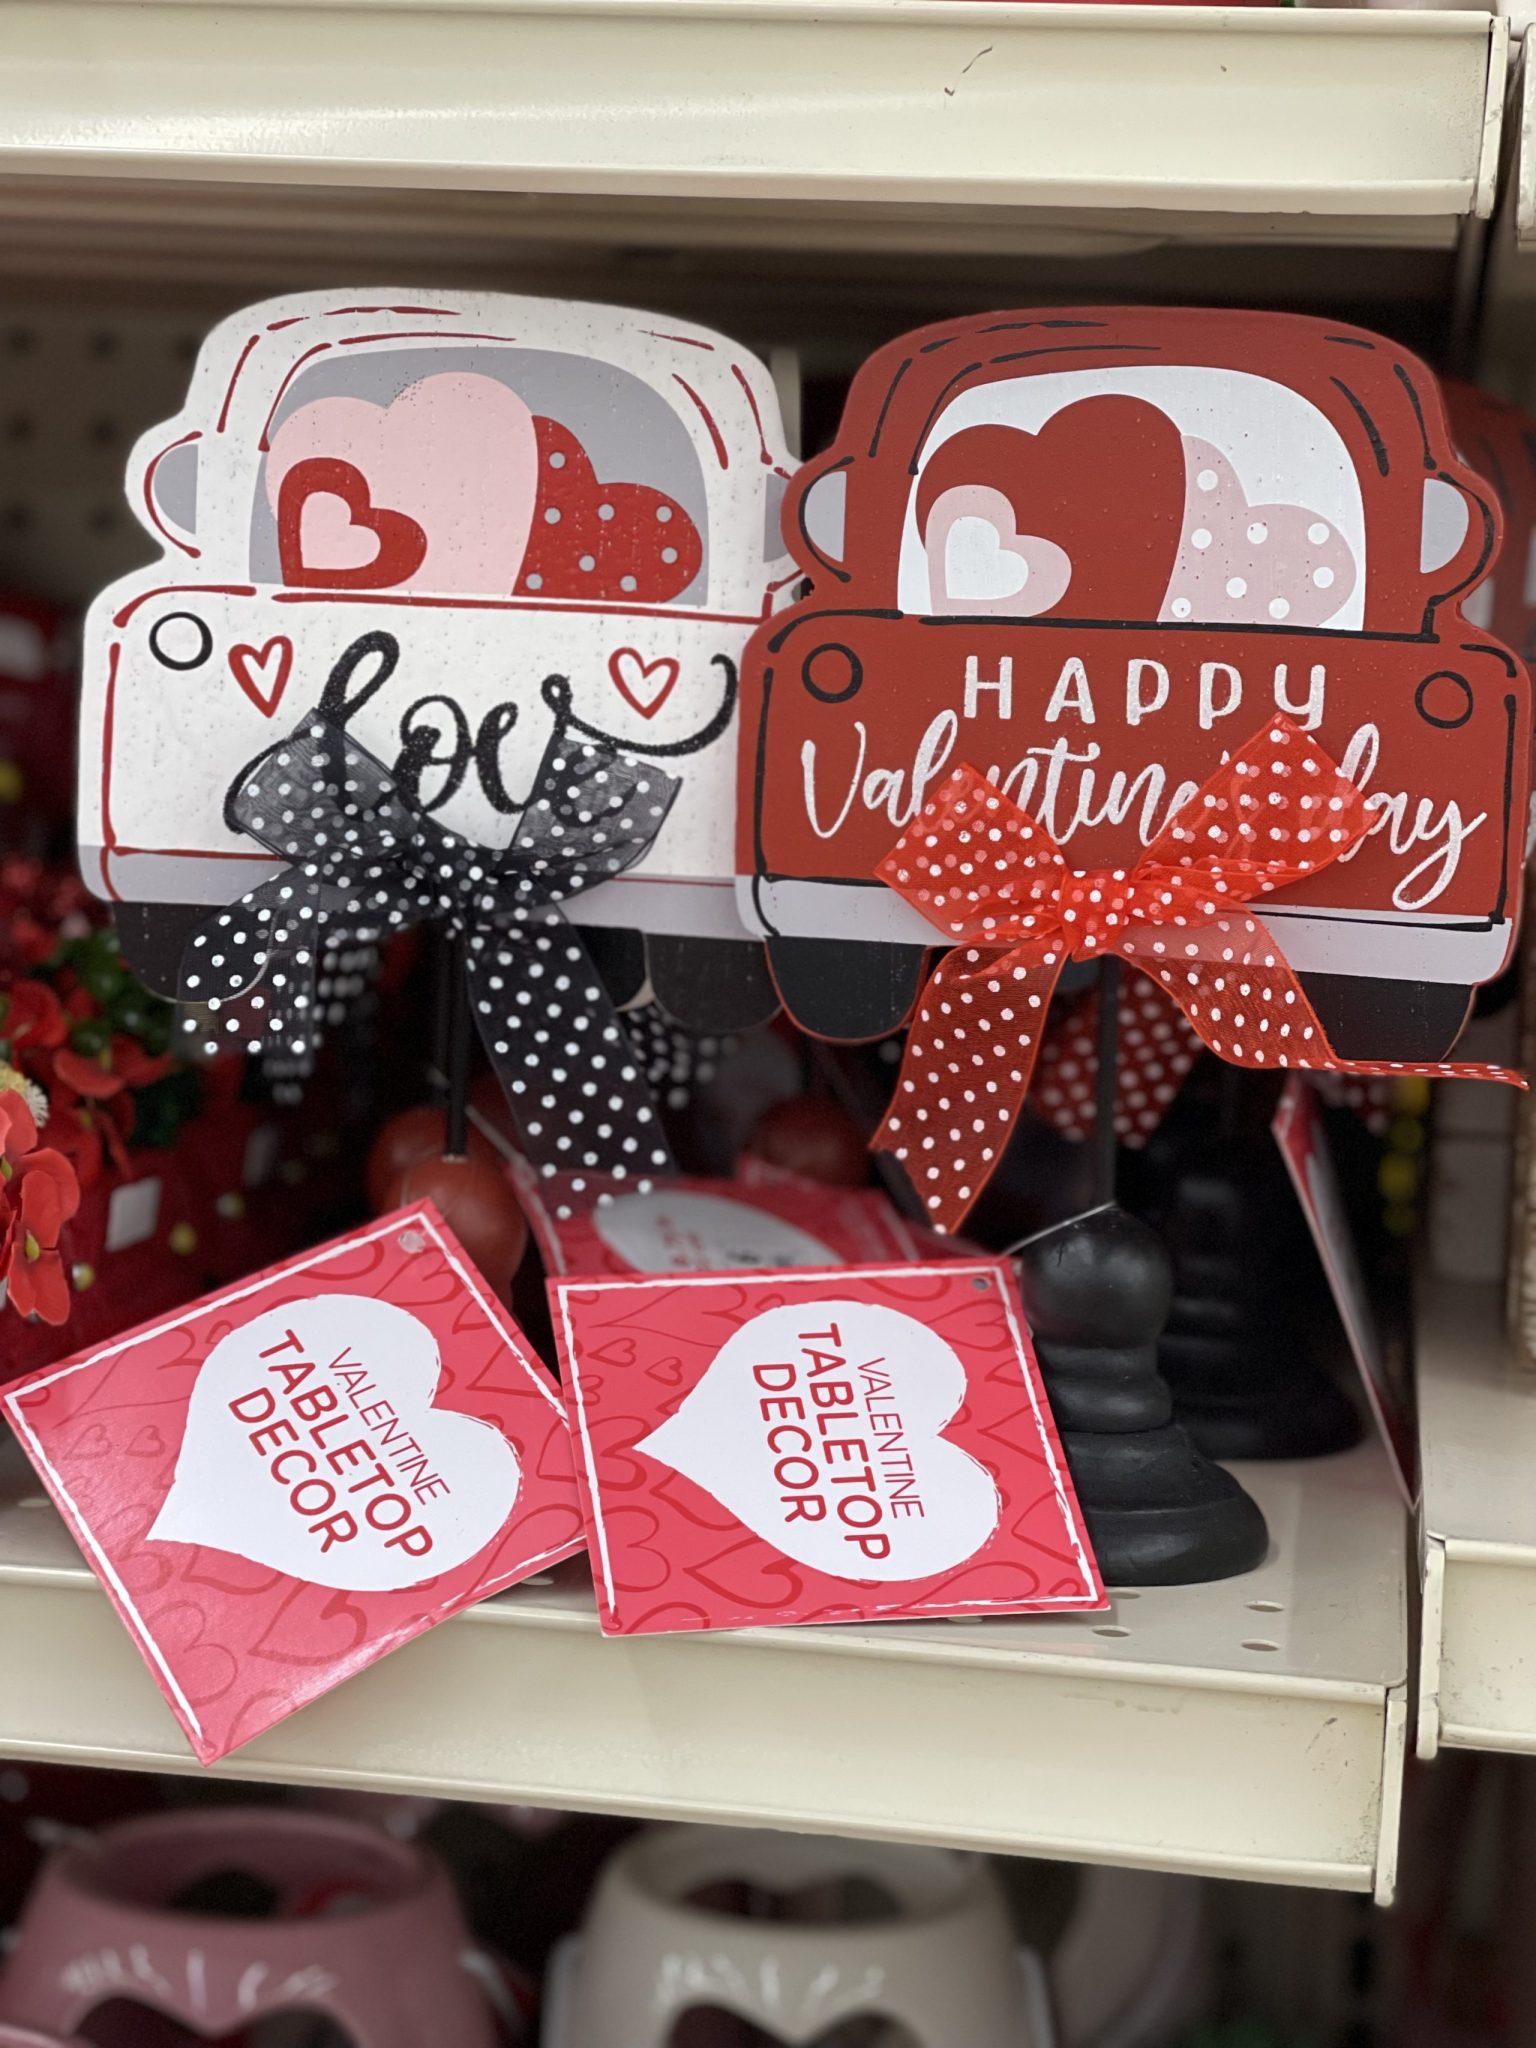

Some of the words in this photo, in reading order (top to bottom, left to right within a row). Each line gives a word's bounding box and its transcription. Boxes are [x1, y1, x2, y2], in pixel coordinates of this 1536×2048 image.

[963, 654, 1326, 731] HAPPY
[228, 1386, 359, 1554] DECOR
[258, 1328, 434, 1557] TABLETOP
[328, 1346, 451, 1506] VALENTINE
[752, 1363, 828, 1523] DECOR
[797, 1322, 892, 1560] TABLETOP
[857, 1356, 926, 1520] VALENTINE
